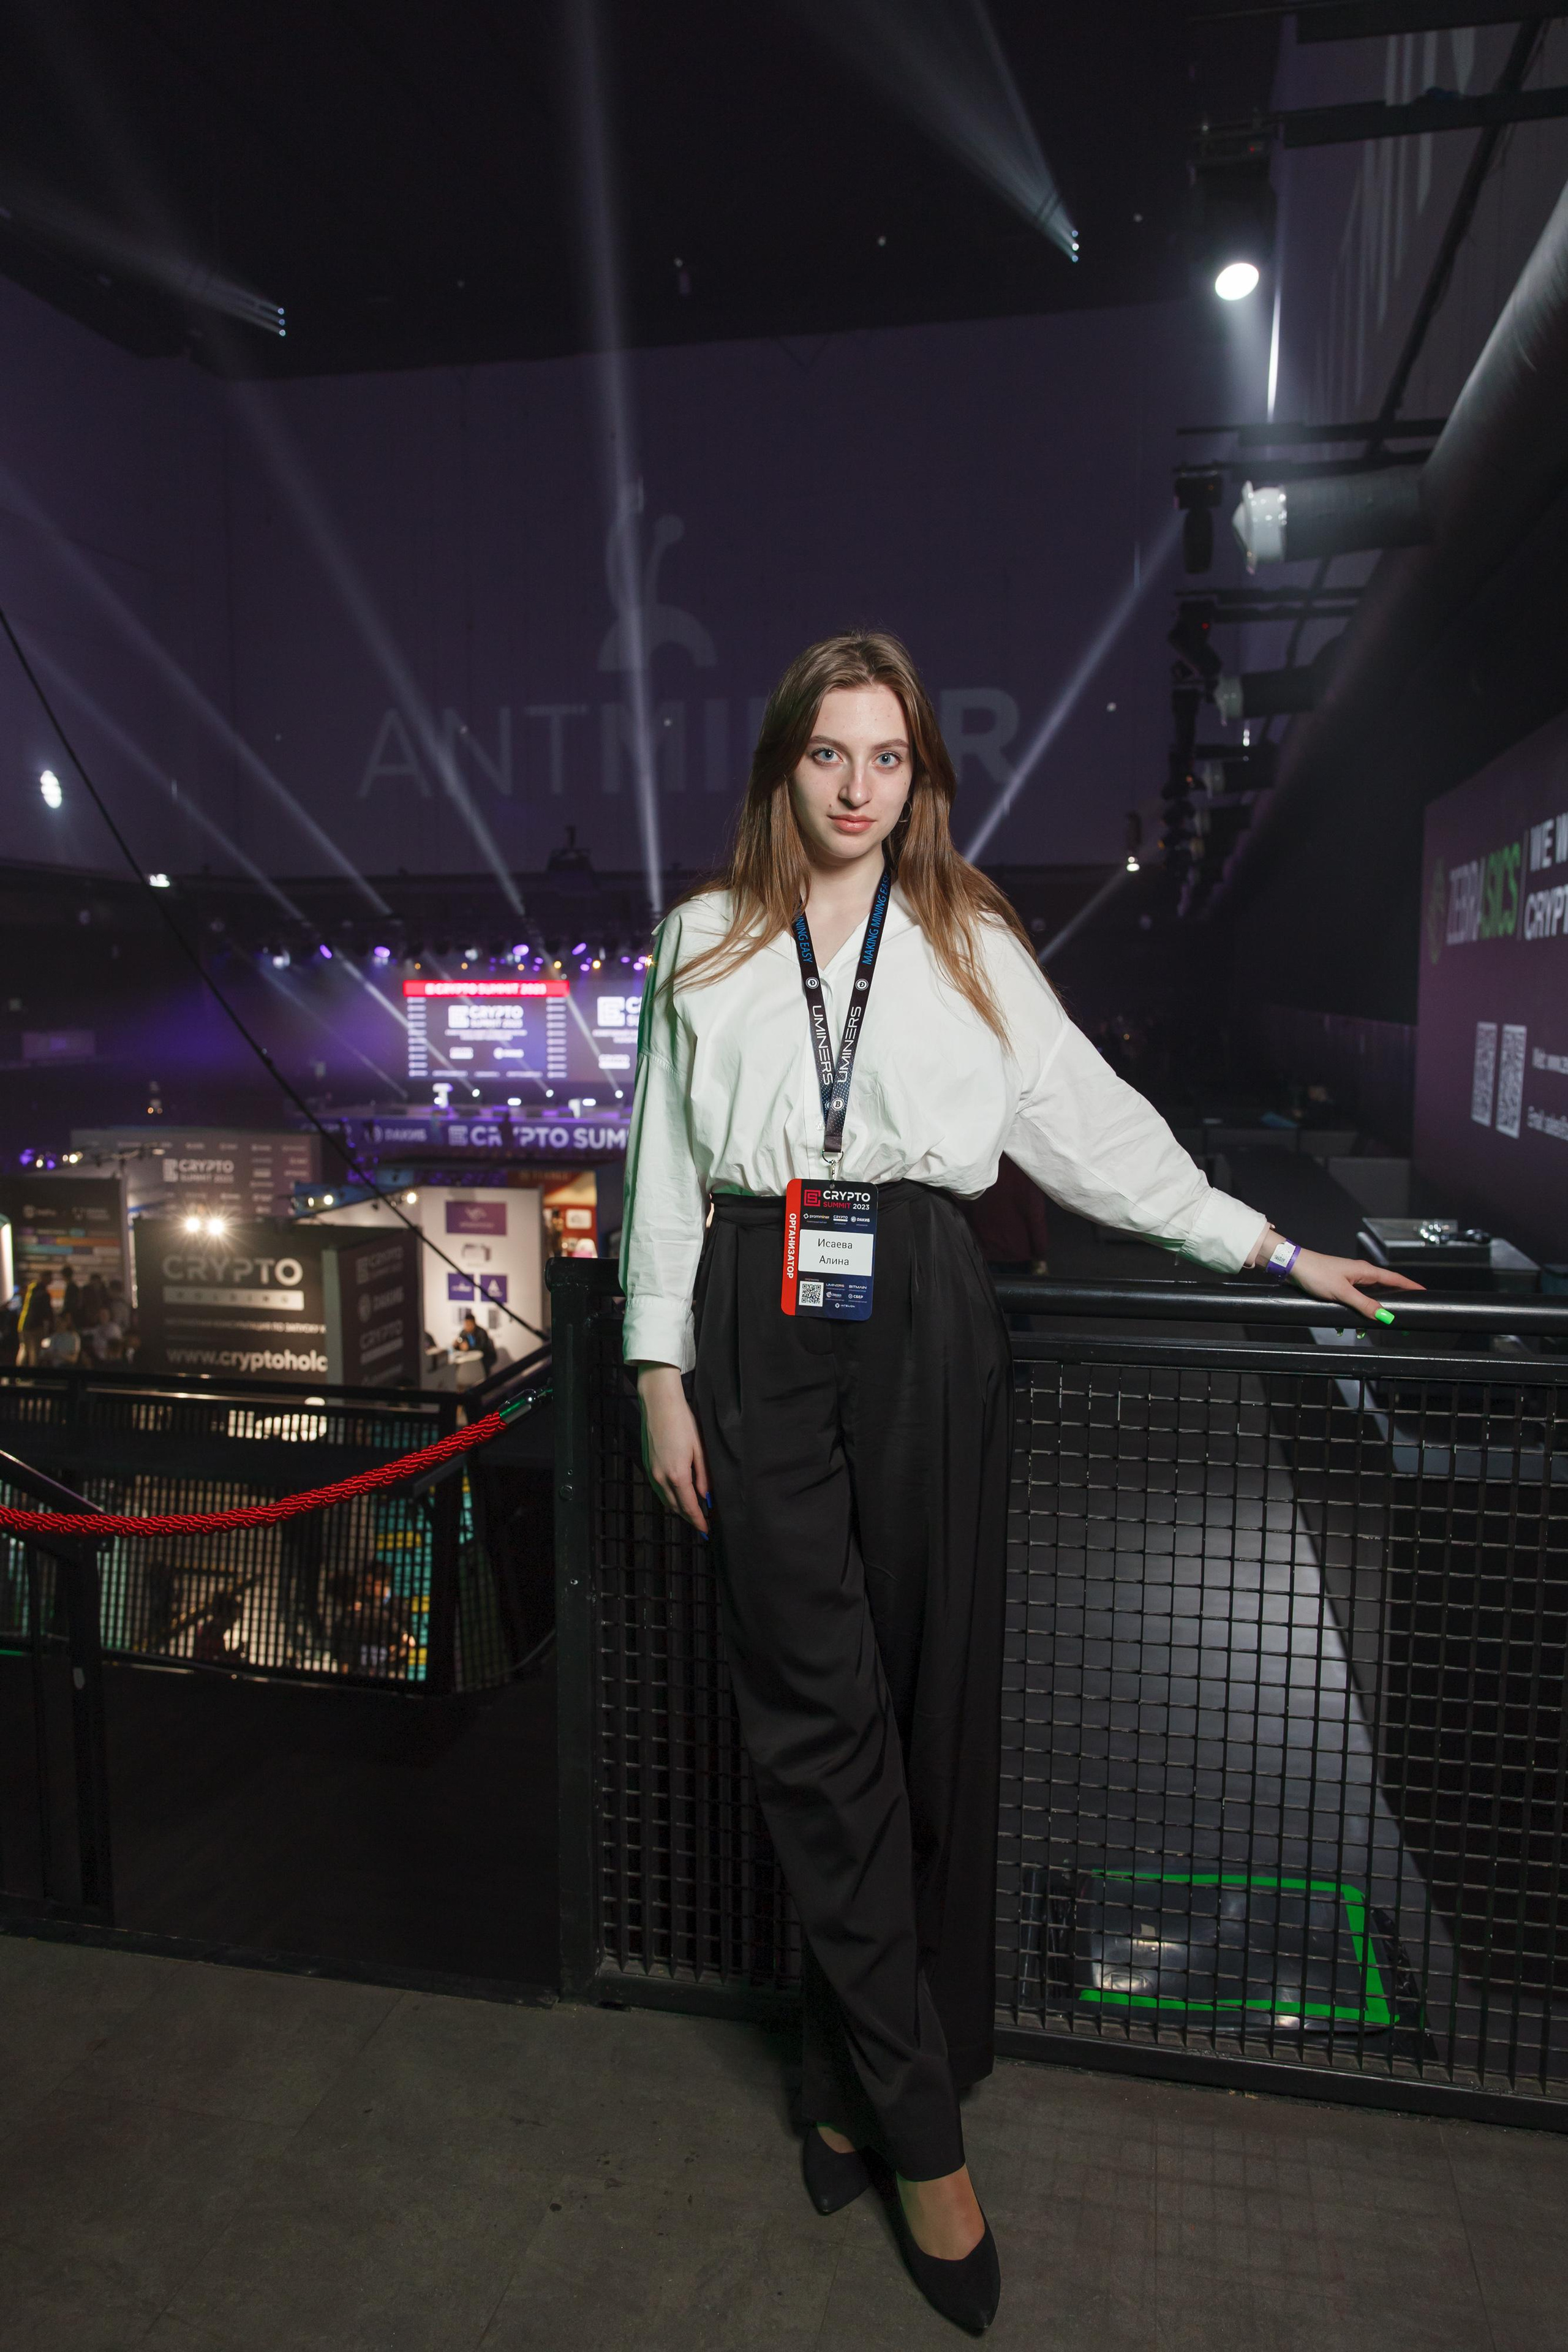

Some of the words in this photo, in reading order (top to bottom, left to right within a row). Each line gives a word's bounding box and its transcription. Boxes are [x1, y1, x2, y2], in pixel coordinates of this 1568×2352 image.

[357, 687, 1021, 798] ANTMIR
[870, 894, 886, 928] MINING
[800, 942, 813, 963] EASY
[862, 929, 879, 965] MAKING
[812, 1005, 834, 1085] UMINERS
[837, 1006, 862, 1083] UMINERS
[470, 1126, 570, 1148] CRPTO
[573, 1128, 630, 1149] SUM
[823, 1190, 870, 1202] CRYPTO
[786, 1213, 797, 1279] ОРГАНИЗАТОР
[818, 1238, 853, 1249] Исаева
[819, 1255, 849, 1265] Алина
[162, 1254, 303, 1287] CRYPTO
